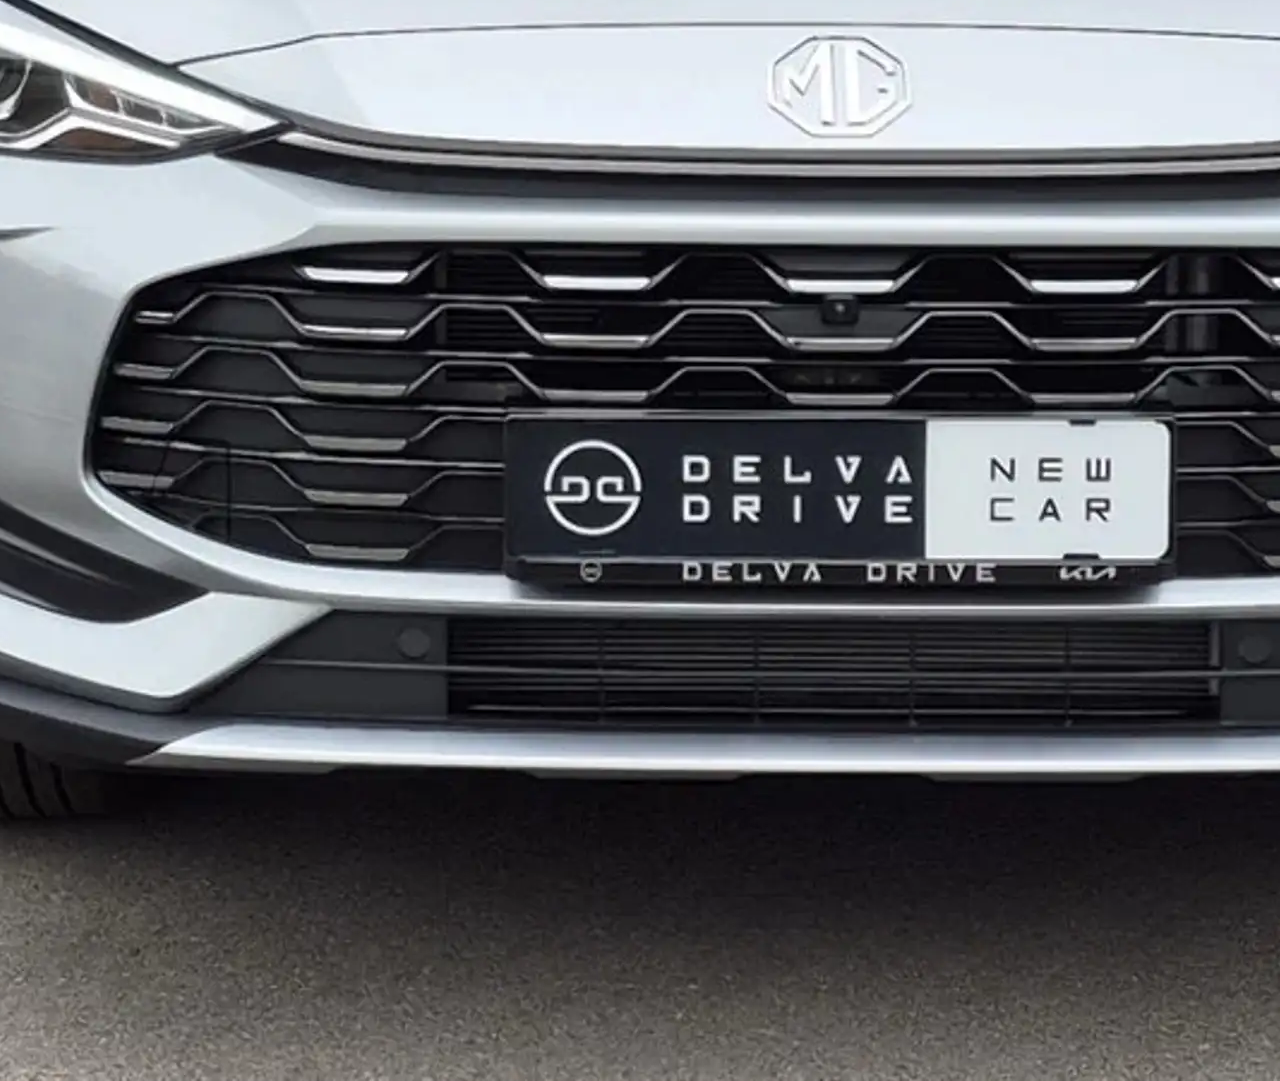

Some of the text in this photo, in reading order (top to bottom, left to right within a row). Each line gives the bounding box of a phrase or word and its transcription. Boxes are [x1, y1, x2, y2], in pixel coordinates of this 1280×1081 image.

[776, 37, 904, 129] MG
[681, 455, 913, 484] DELVA
[989, 457, 1112, 482] NEW
[681, 495, 913, 523] DRIVE
[989, 497, 1112, 522] CAR
[681, 562, 822, 582] DELVA
[866, 563, 997, 583] DRIVE
